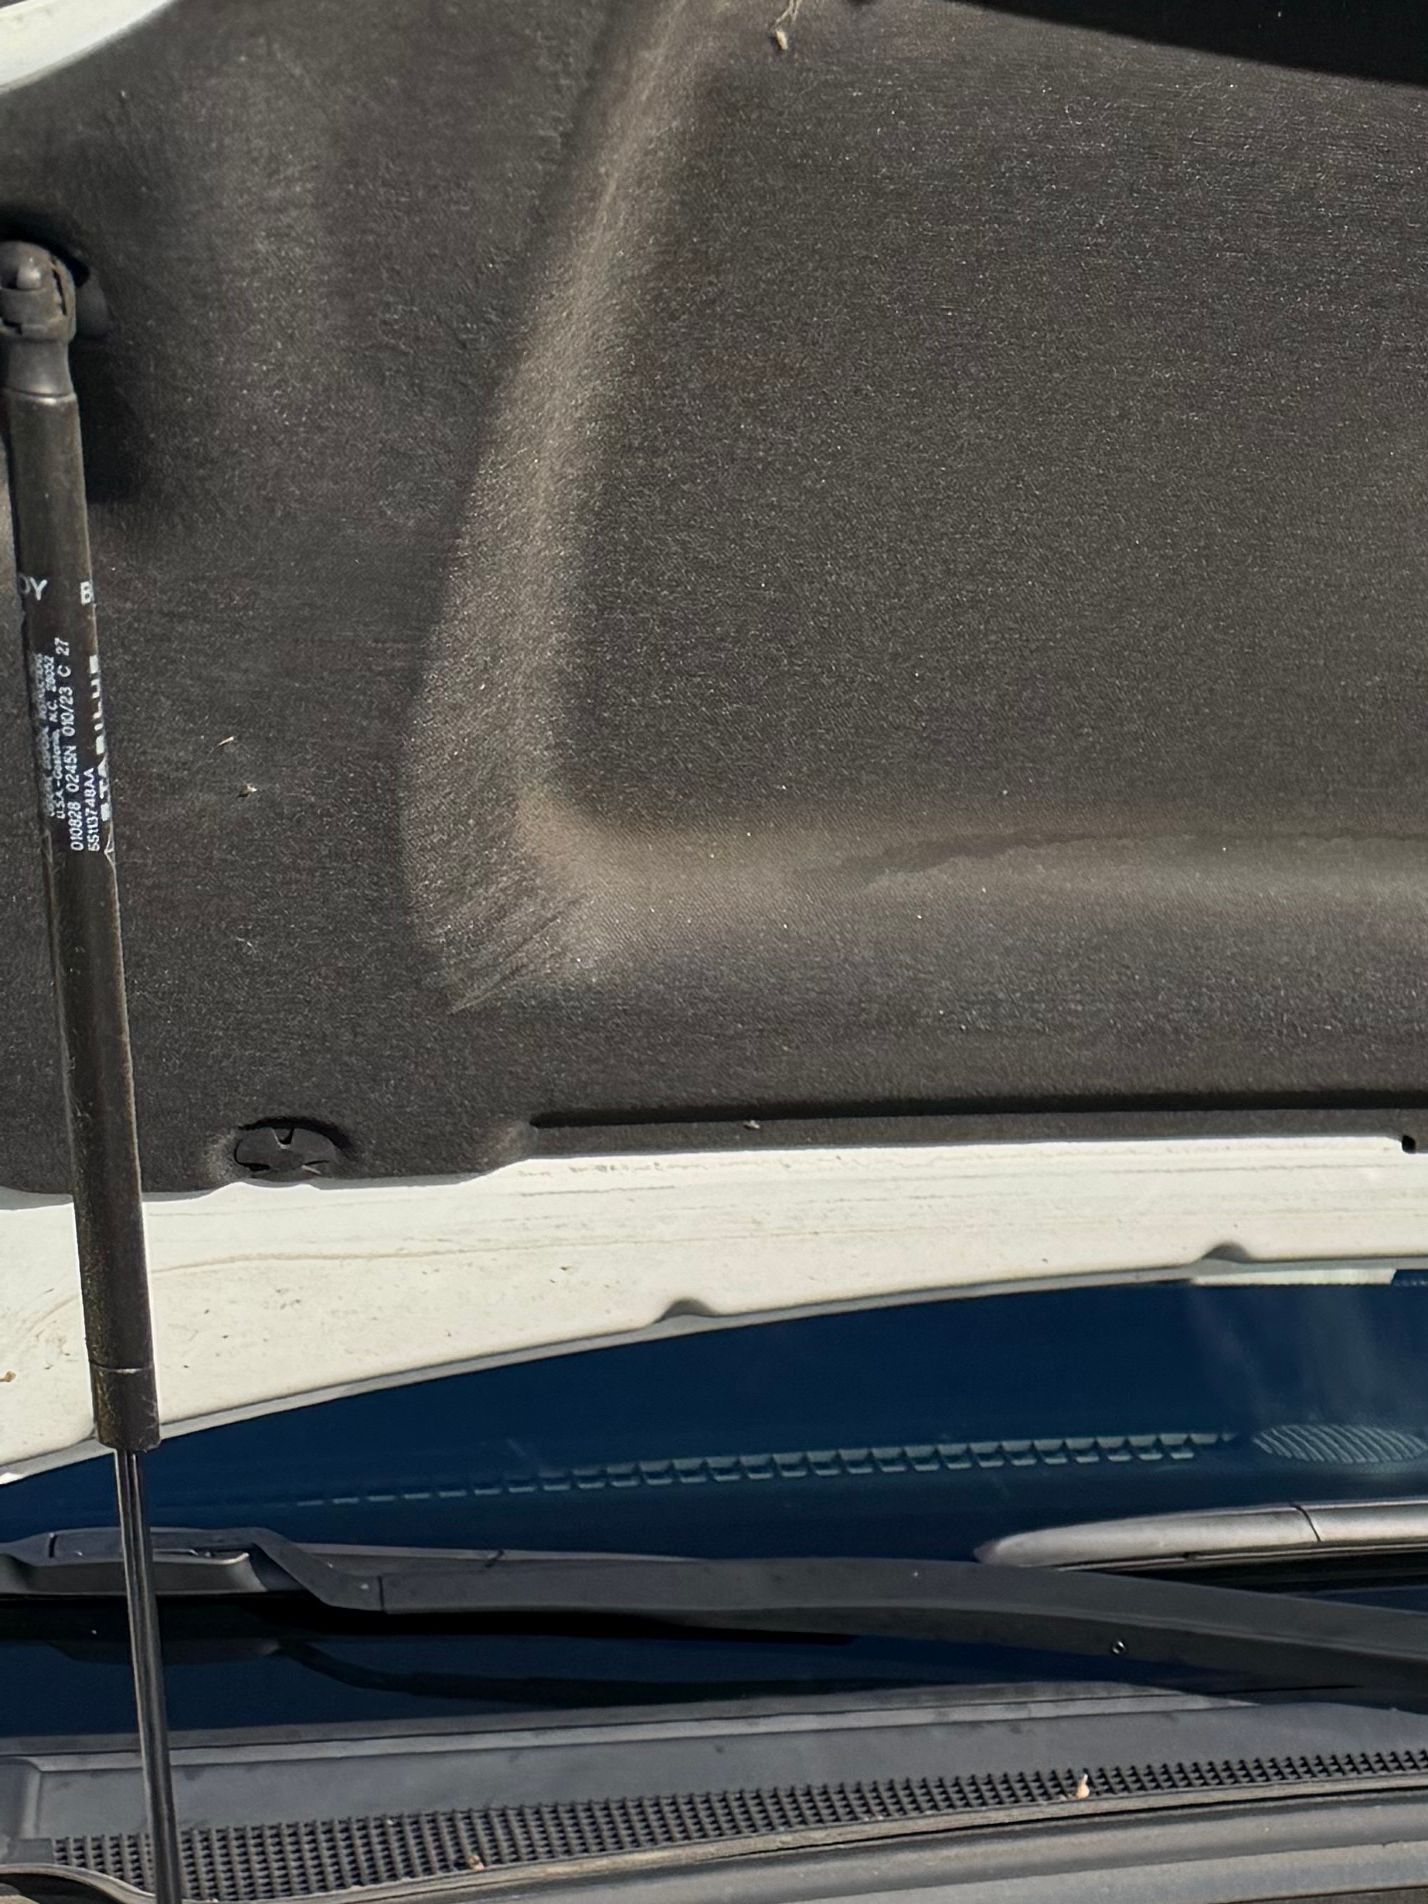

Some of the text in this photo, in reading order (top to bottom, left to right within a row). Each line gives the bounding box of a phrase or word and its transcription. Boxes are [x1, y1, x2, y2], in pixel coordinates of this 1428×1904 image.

[54, 637, 84, 851] 010828 0245N 010/23 C 27
